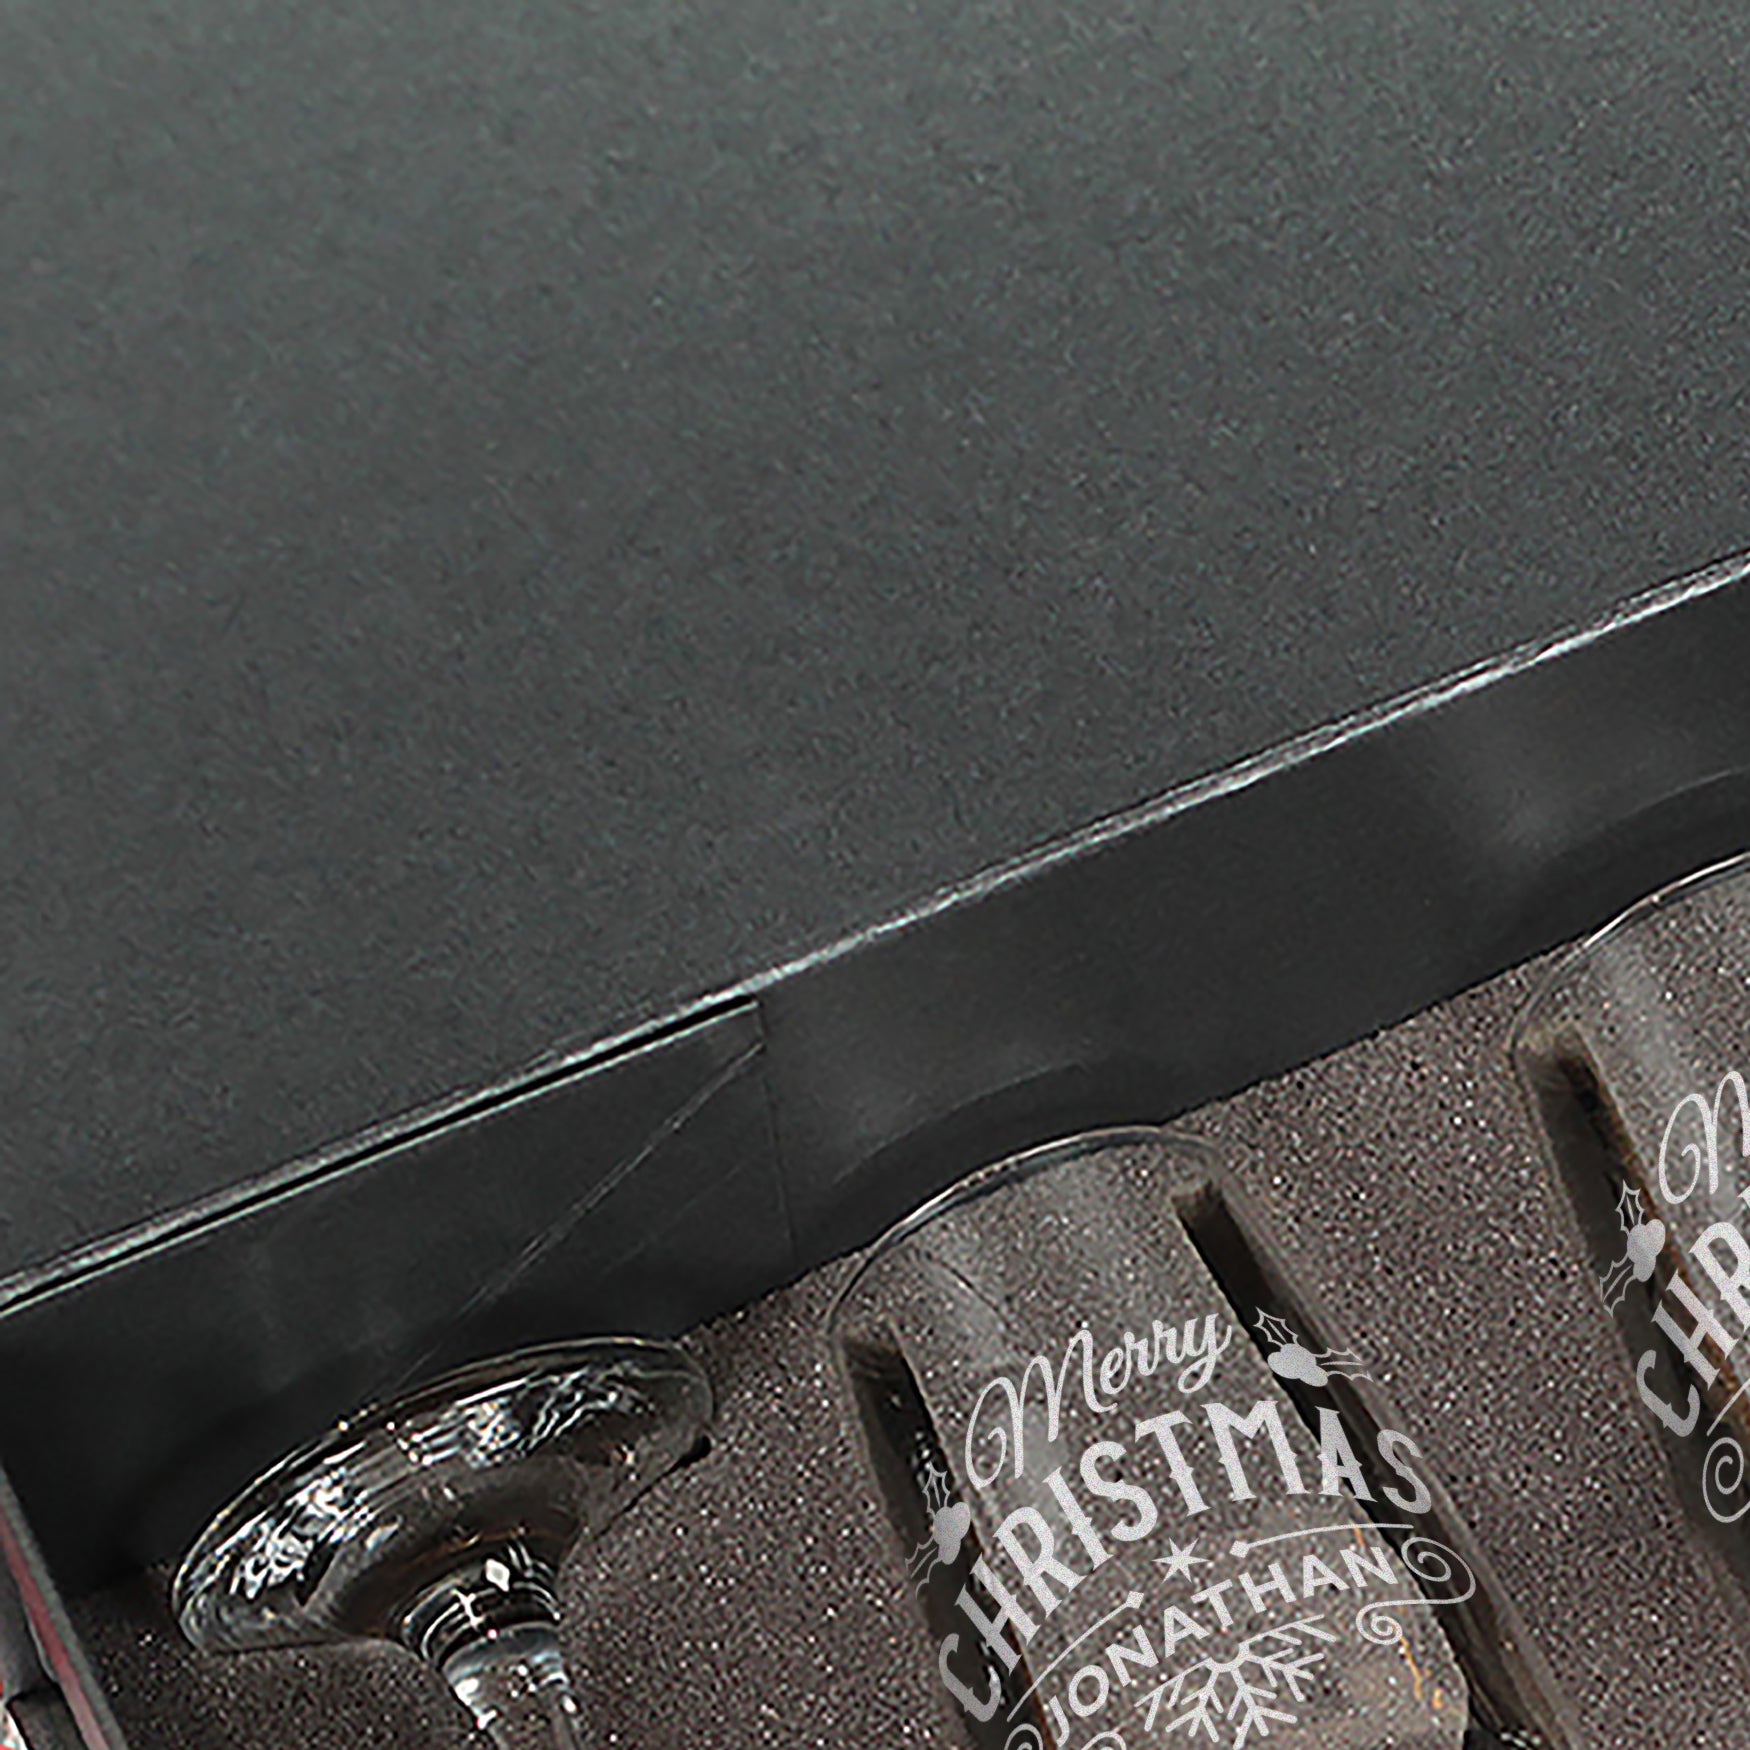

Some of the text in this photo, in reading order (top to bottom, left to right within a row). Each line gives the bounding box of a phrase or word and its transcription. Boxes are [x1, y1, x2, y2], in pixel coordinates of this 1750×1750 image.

[965, 1313, 1232, 1490] Merry
[938, 1400, 1432, 1722] CHRISTMAS
[1045, 1546, 1399, 1748] JONATHAN
